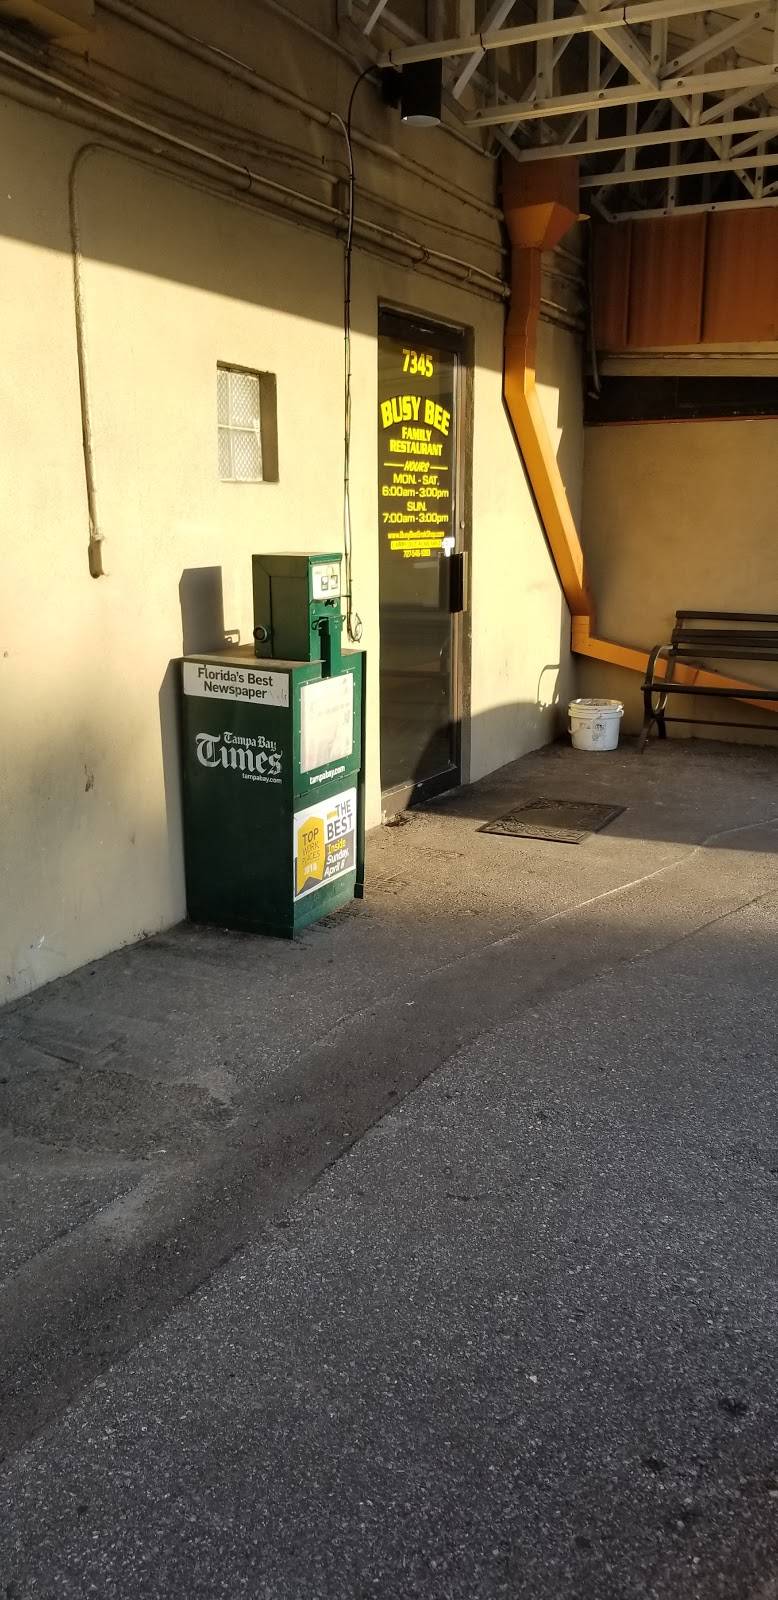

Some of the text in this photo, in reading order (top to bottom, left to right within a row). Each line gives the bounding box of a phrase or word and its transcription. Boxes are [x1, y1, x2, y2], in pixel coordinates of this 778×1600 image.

[402, 348, 433, 377] 7345
[381, 395, 450, 436] BUSY BEE
[401, 426, 432, 441] FAMILY
[389, 439, 443, 456] RESTAURANT
[404, 461, 430, 472] HOURS
[393, 473, 417, 484] MON.
[422, 475, 440, 486] SAT.
[407, 502, 427, 511] SUN.
[197, 664, 274, 687] Florida's Best
[204, 681, 267, 699] Newspaper
[223, 731, 277, 752] Tampa Bay
[195, 732, 283, 775] Times
[242, 772, 283, 784] tampabay.com
[309, 765, 346, 785] tampabay.com
[335, 799, 352, 817] THE
[327, 813, 353, 841] BEST
[302, 828, 319, 846] TOP
[327, 838, 346, 854] Inside
[324, 862, 340, 878] April
